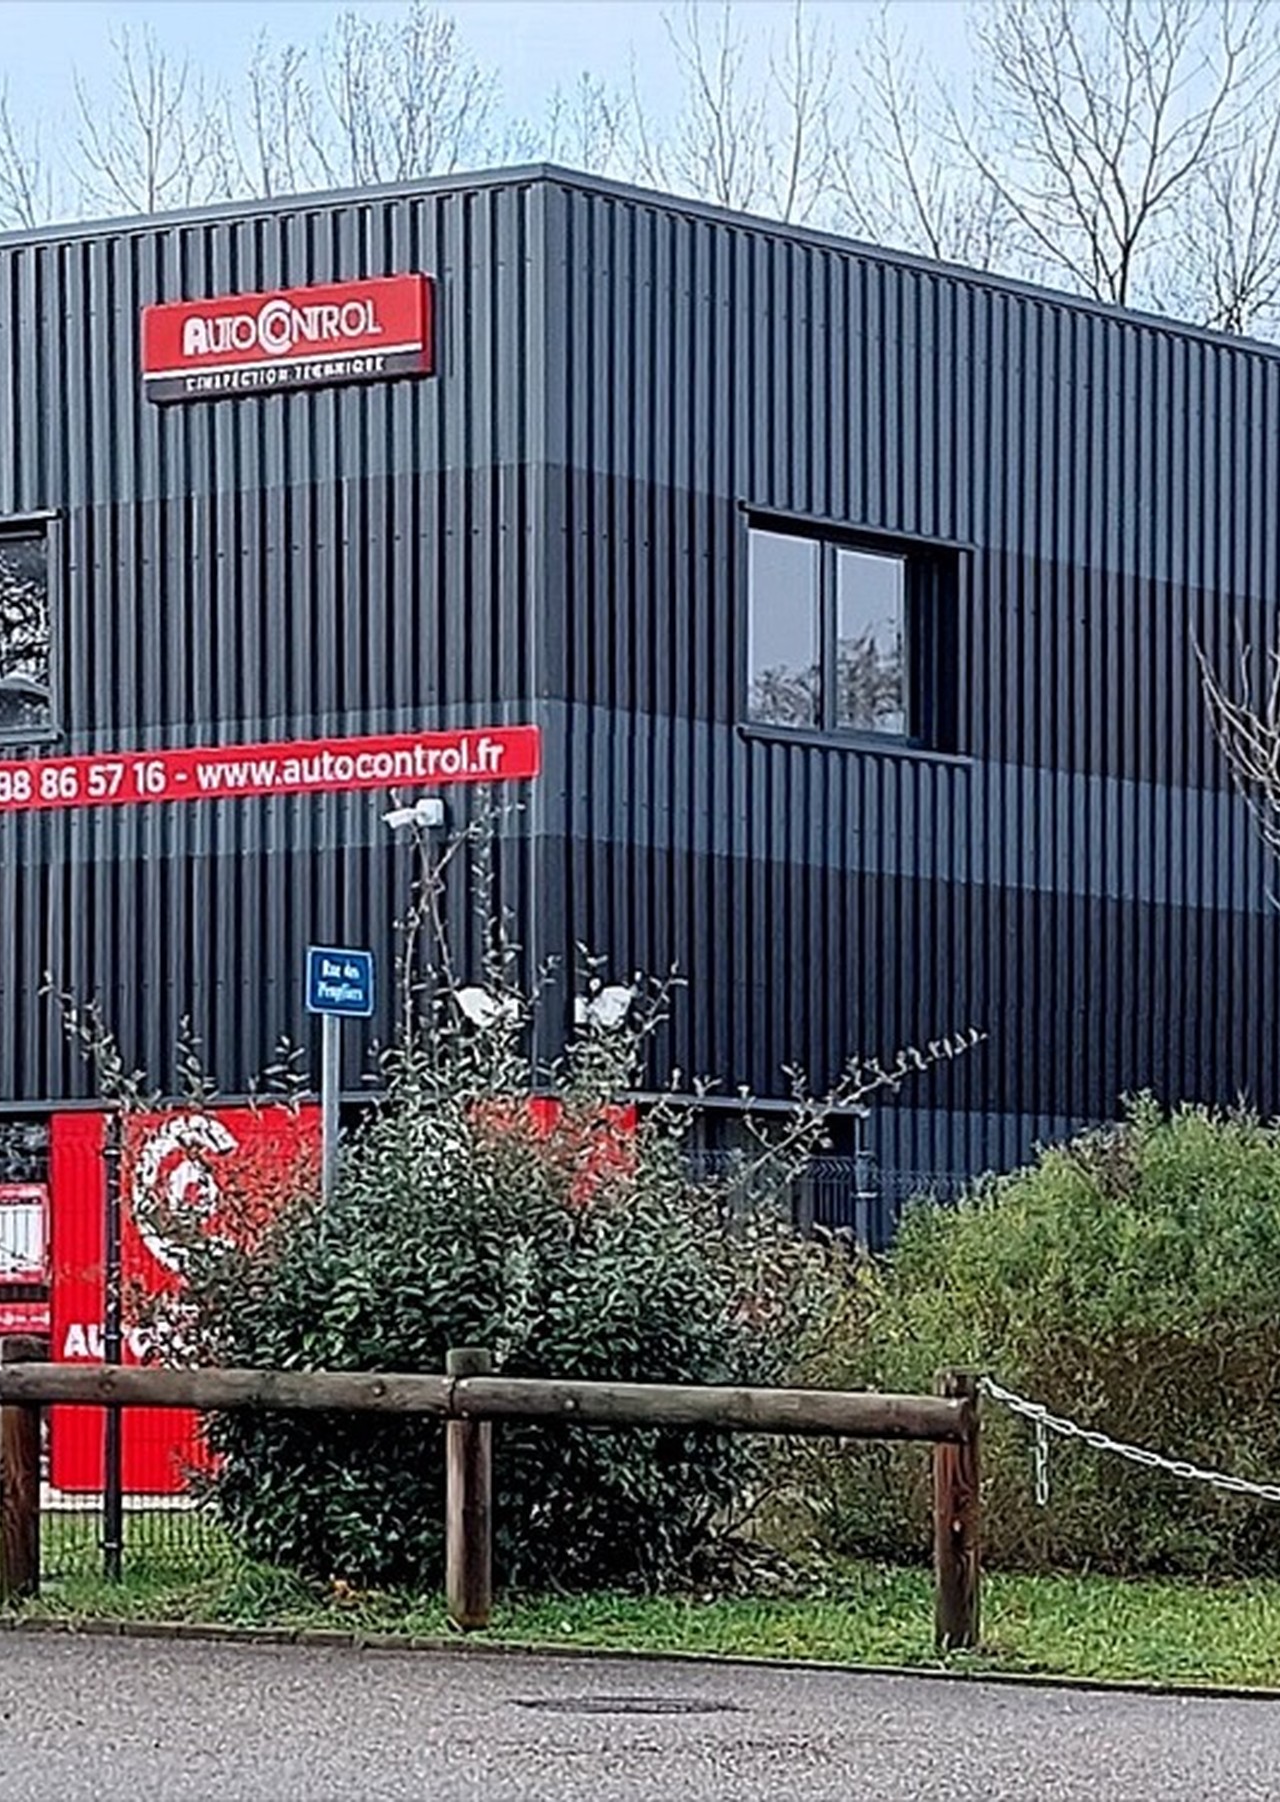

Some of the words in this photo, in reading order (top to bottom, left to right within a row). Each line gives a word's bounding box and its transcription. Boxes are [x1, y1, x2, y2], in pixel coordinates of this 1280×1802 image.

[183, 299, 382, 355] AUTOCONTROL
[40, 767, 78, 798] 86
[88, 763, 124, 796] 57
[132, 760, 166, 794] 16
[196, 737, 504, 788] www.autocontrol.fr
